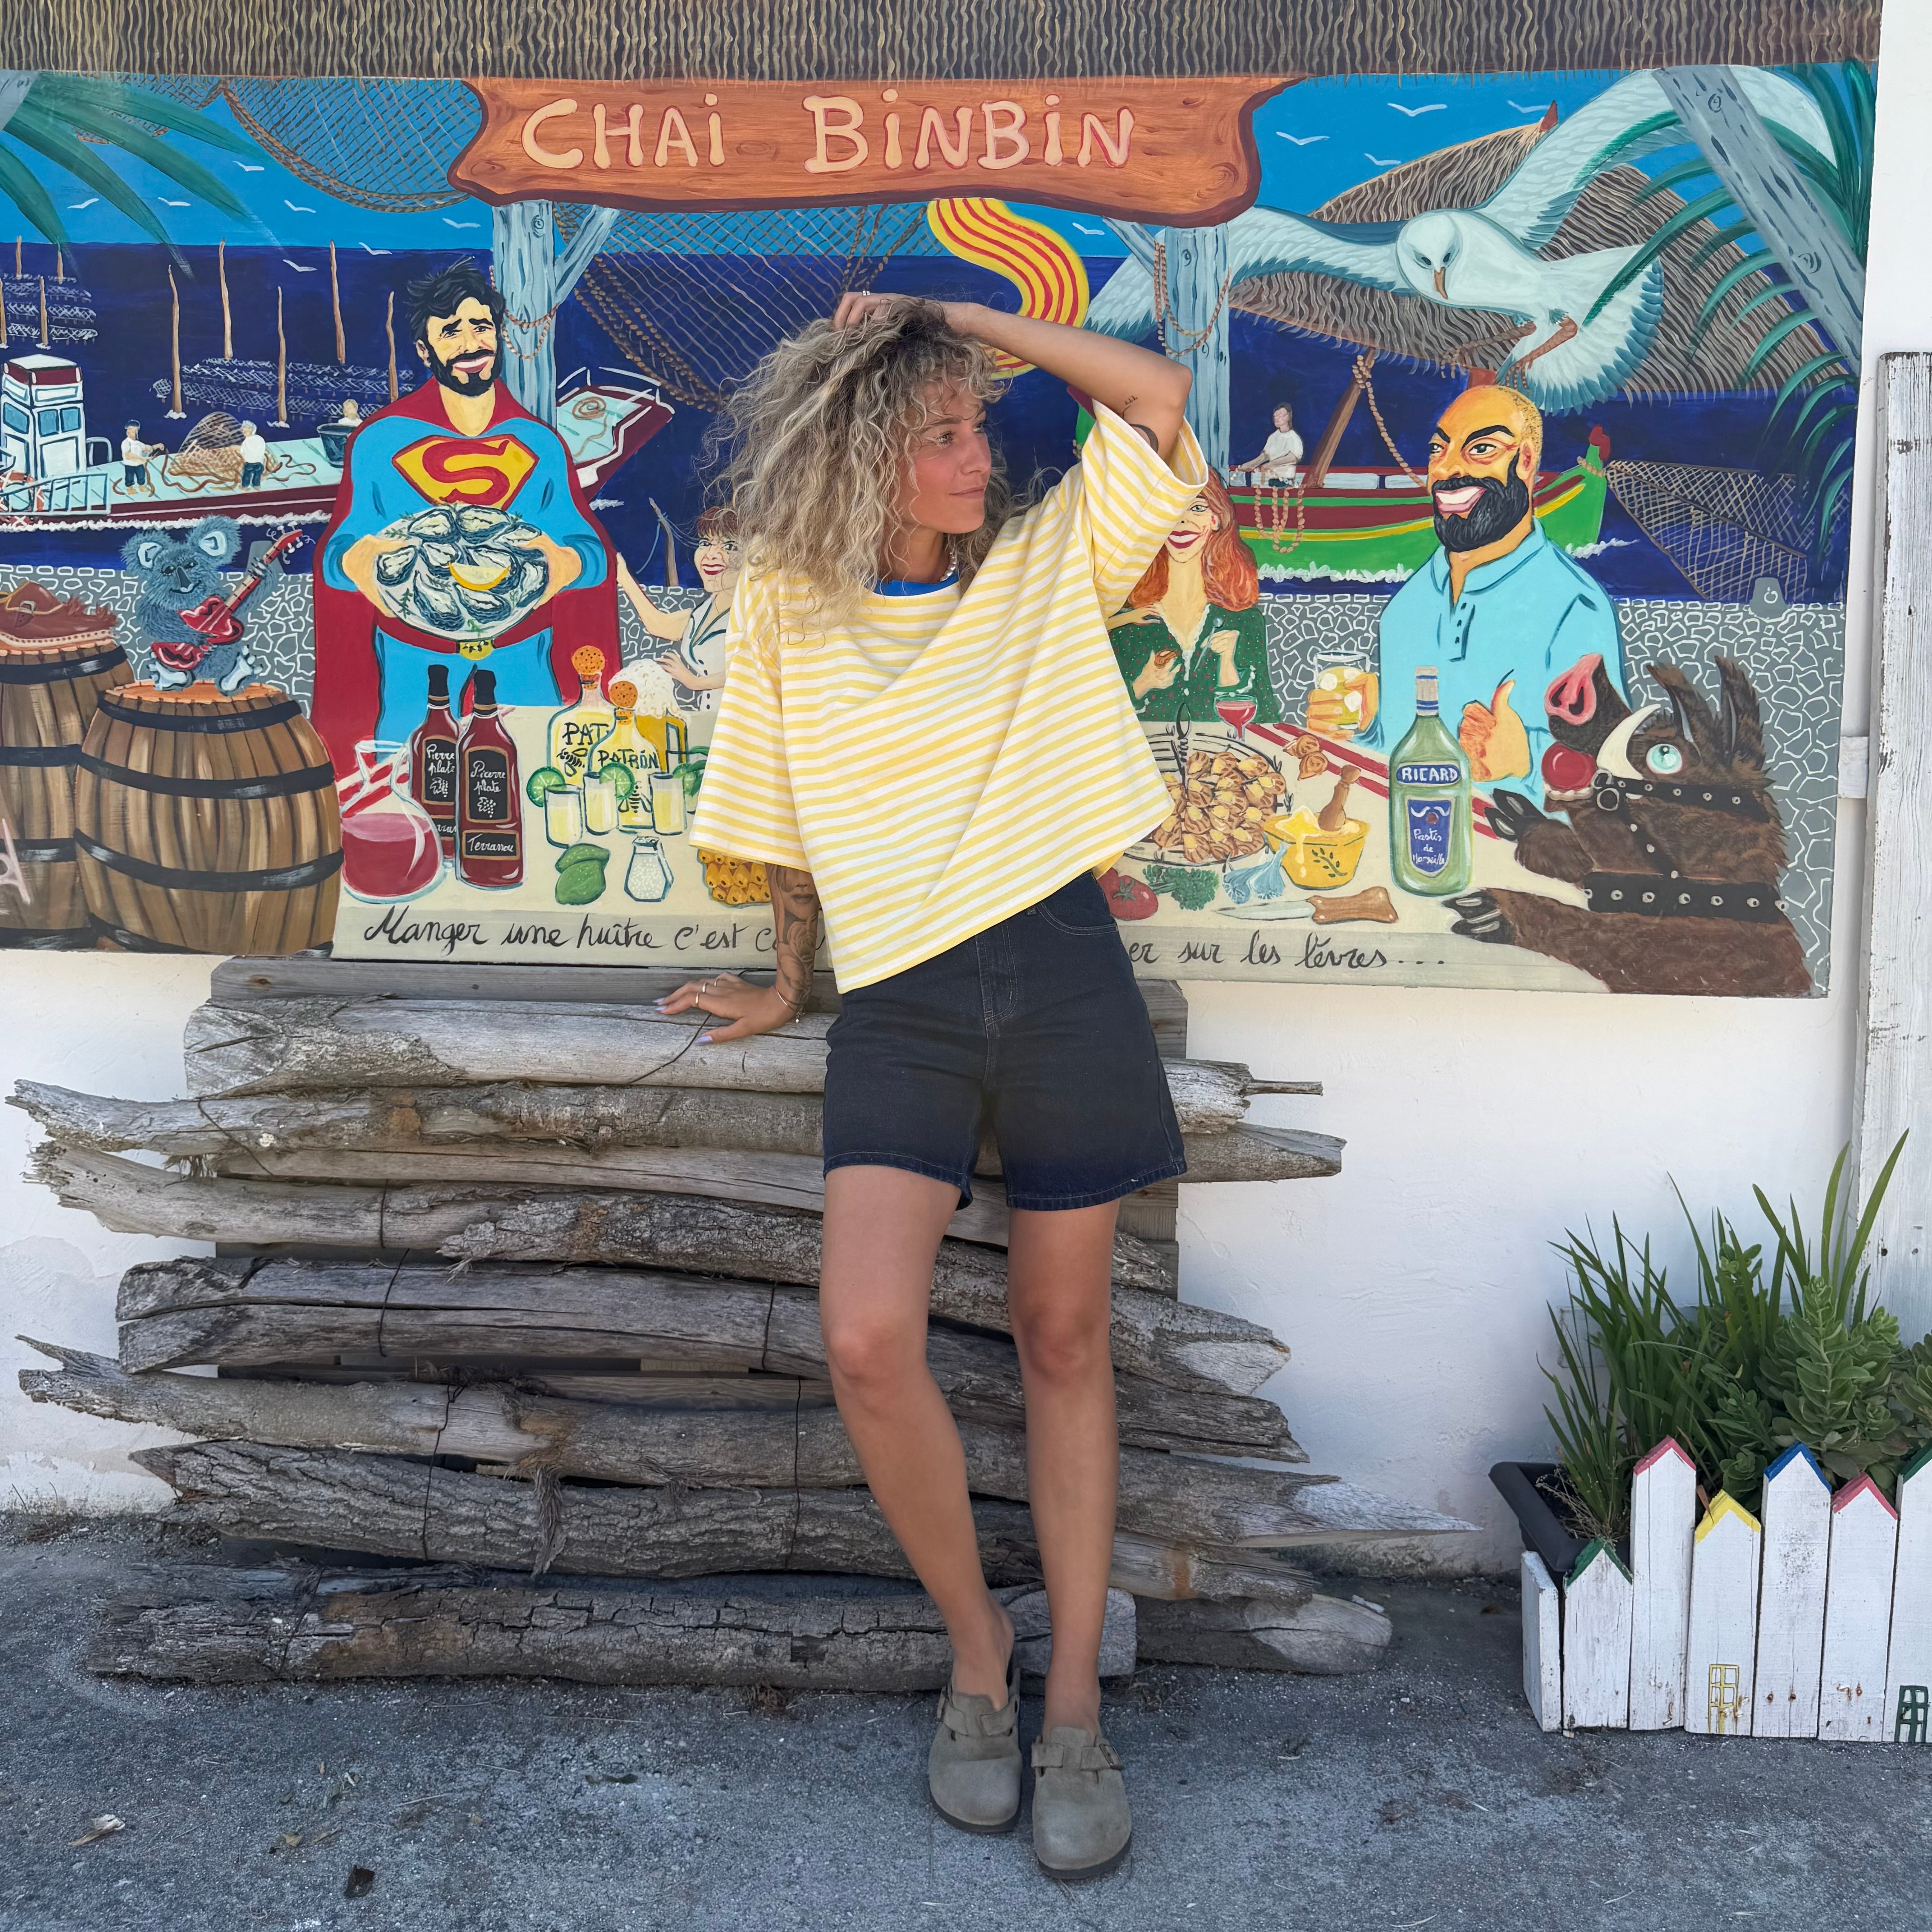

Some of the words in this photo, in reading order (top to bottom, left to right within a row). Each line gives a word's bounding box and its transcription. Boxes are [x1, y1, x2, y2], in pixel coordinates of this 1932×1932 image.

[562, 722, 610, 745] PAT
[428, 760, 455, 776] plate
[1402, 767, 1458, 782] RICARD
[474, 779, 502, 795] plate
[1413, 827, 1442, 842] Pastis
[1423, 843, 1434, 853] de
[364, 904, 490, 956] Manger
[500, 921, 572, 948] une
[576, 912, 666, 950] huître
[1178, 940, 1226, 964] sur
[1240, 929, 1282, 966] les
